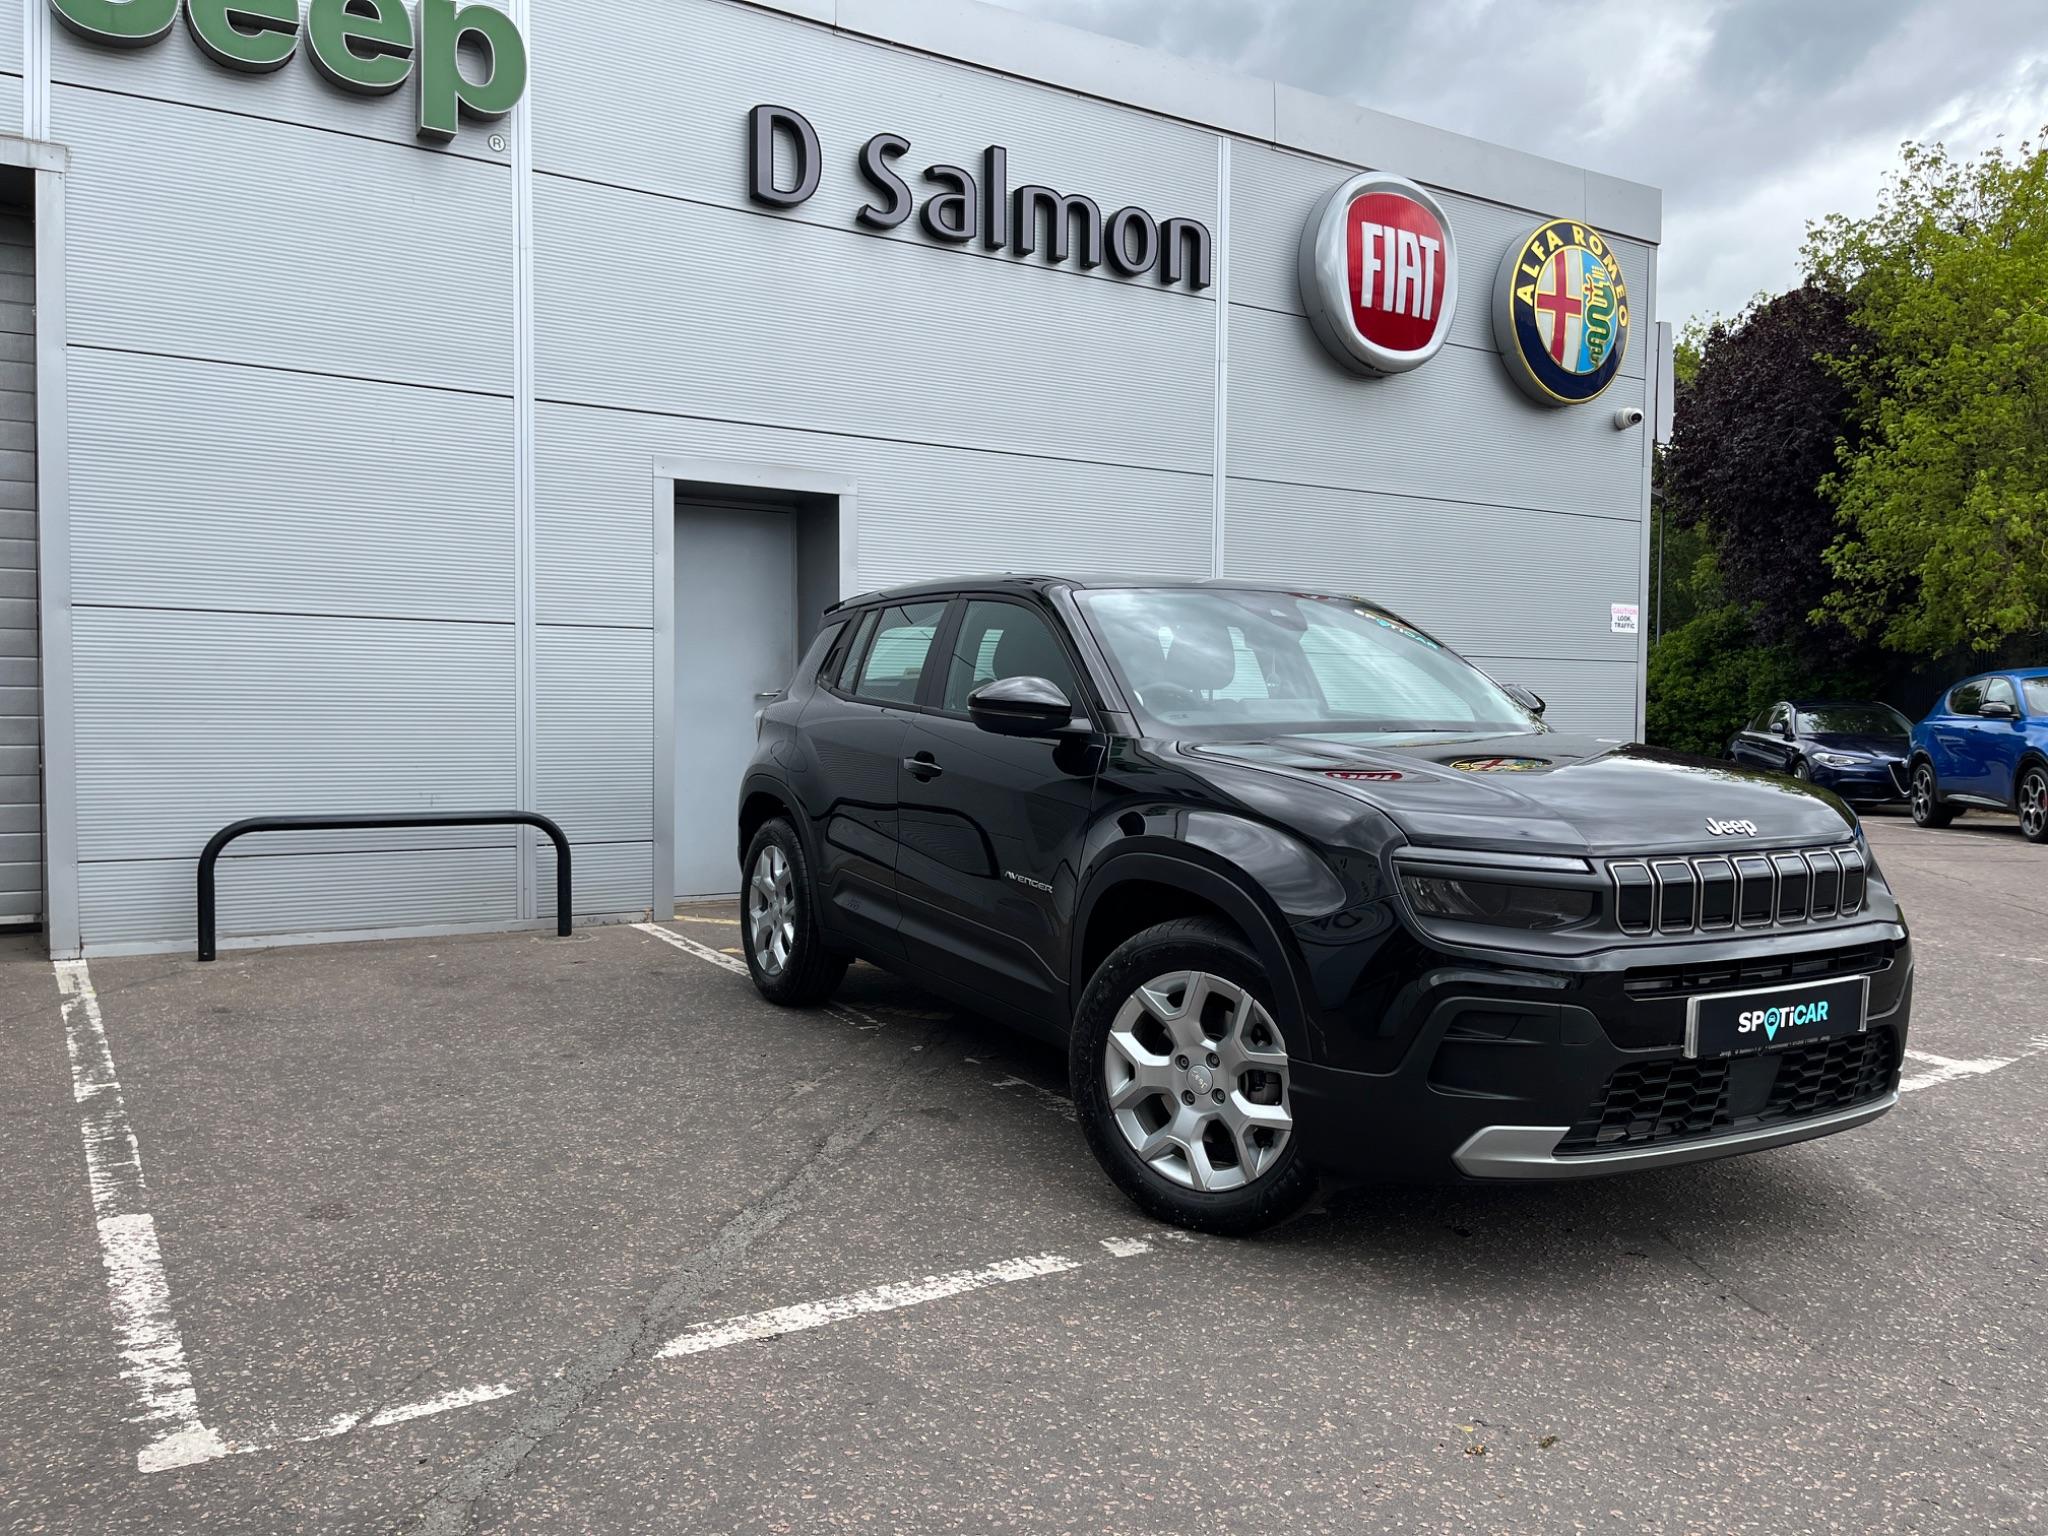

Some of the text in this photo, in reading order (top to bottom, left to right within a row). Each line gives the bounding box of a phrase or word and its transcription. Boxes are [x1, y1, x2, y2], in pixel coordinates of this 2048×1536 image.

[748, 103, 1211, 291] D Salmon
[1360, 220, 1440, 321] FIAT
[1516, 225, 1629, 328] ALFA ROMEO
[1705, 817, 1757, 837] Jeep
[1004, 870, 1053, 894] AVENGER
